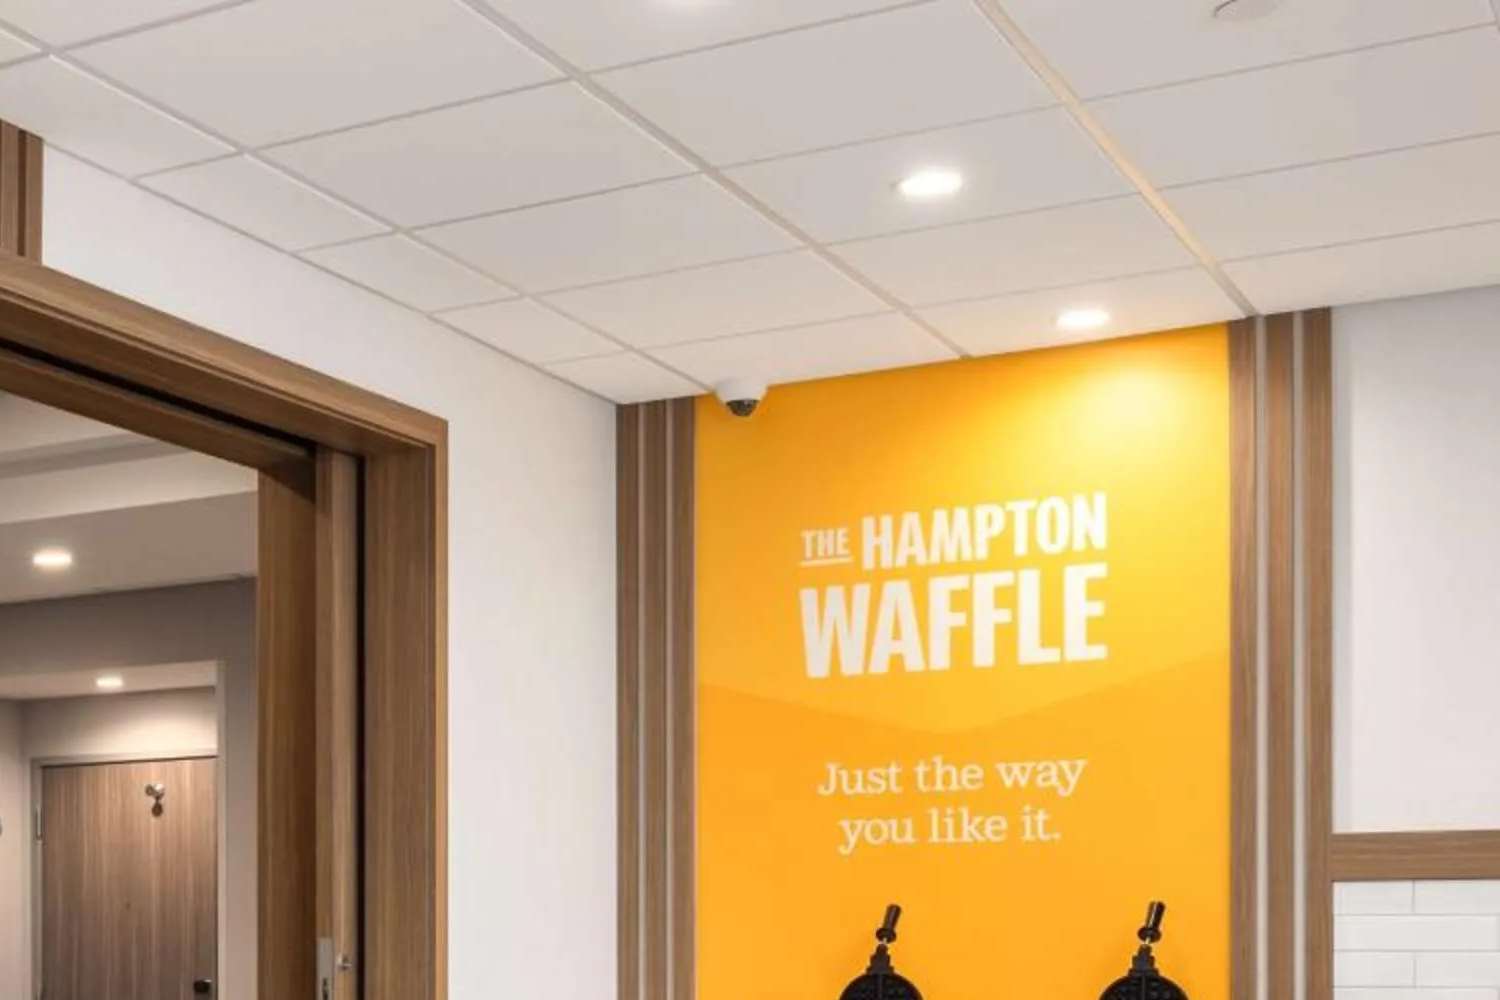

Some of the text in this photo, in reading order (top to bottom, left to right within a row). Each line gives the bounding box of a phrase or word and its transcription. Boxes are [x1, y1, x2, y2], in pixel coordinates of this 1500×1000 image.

[802, 492, 1106, 571] THE HAMPTON
[800, 562, 1108, 679] WAFFLE
[818, 756, 1087, 797] Just the way
[838, 805, 1061, 855] you like it.
